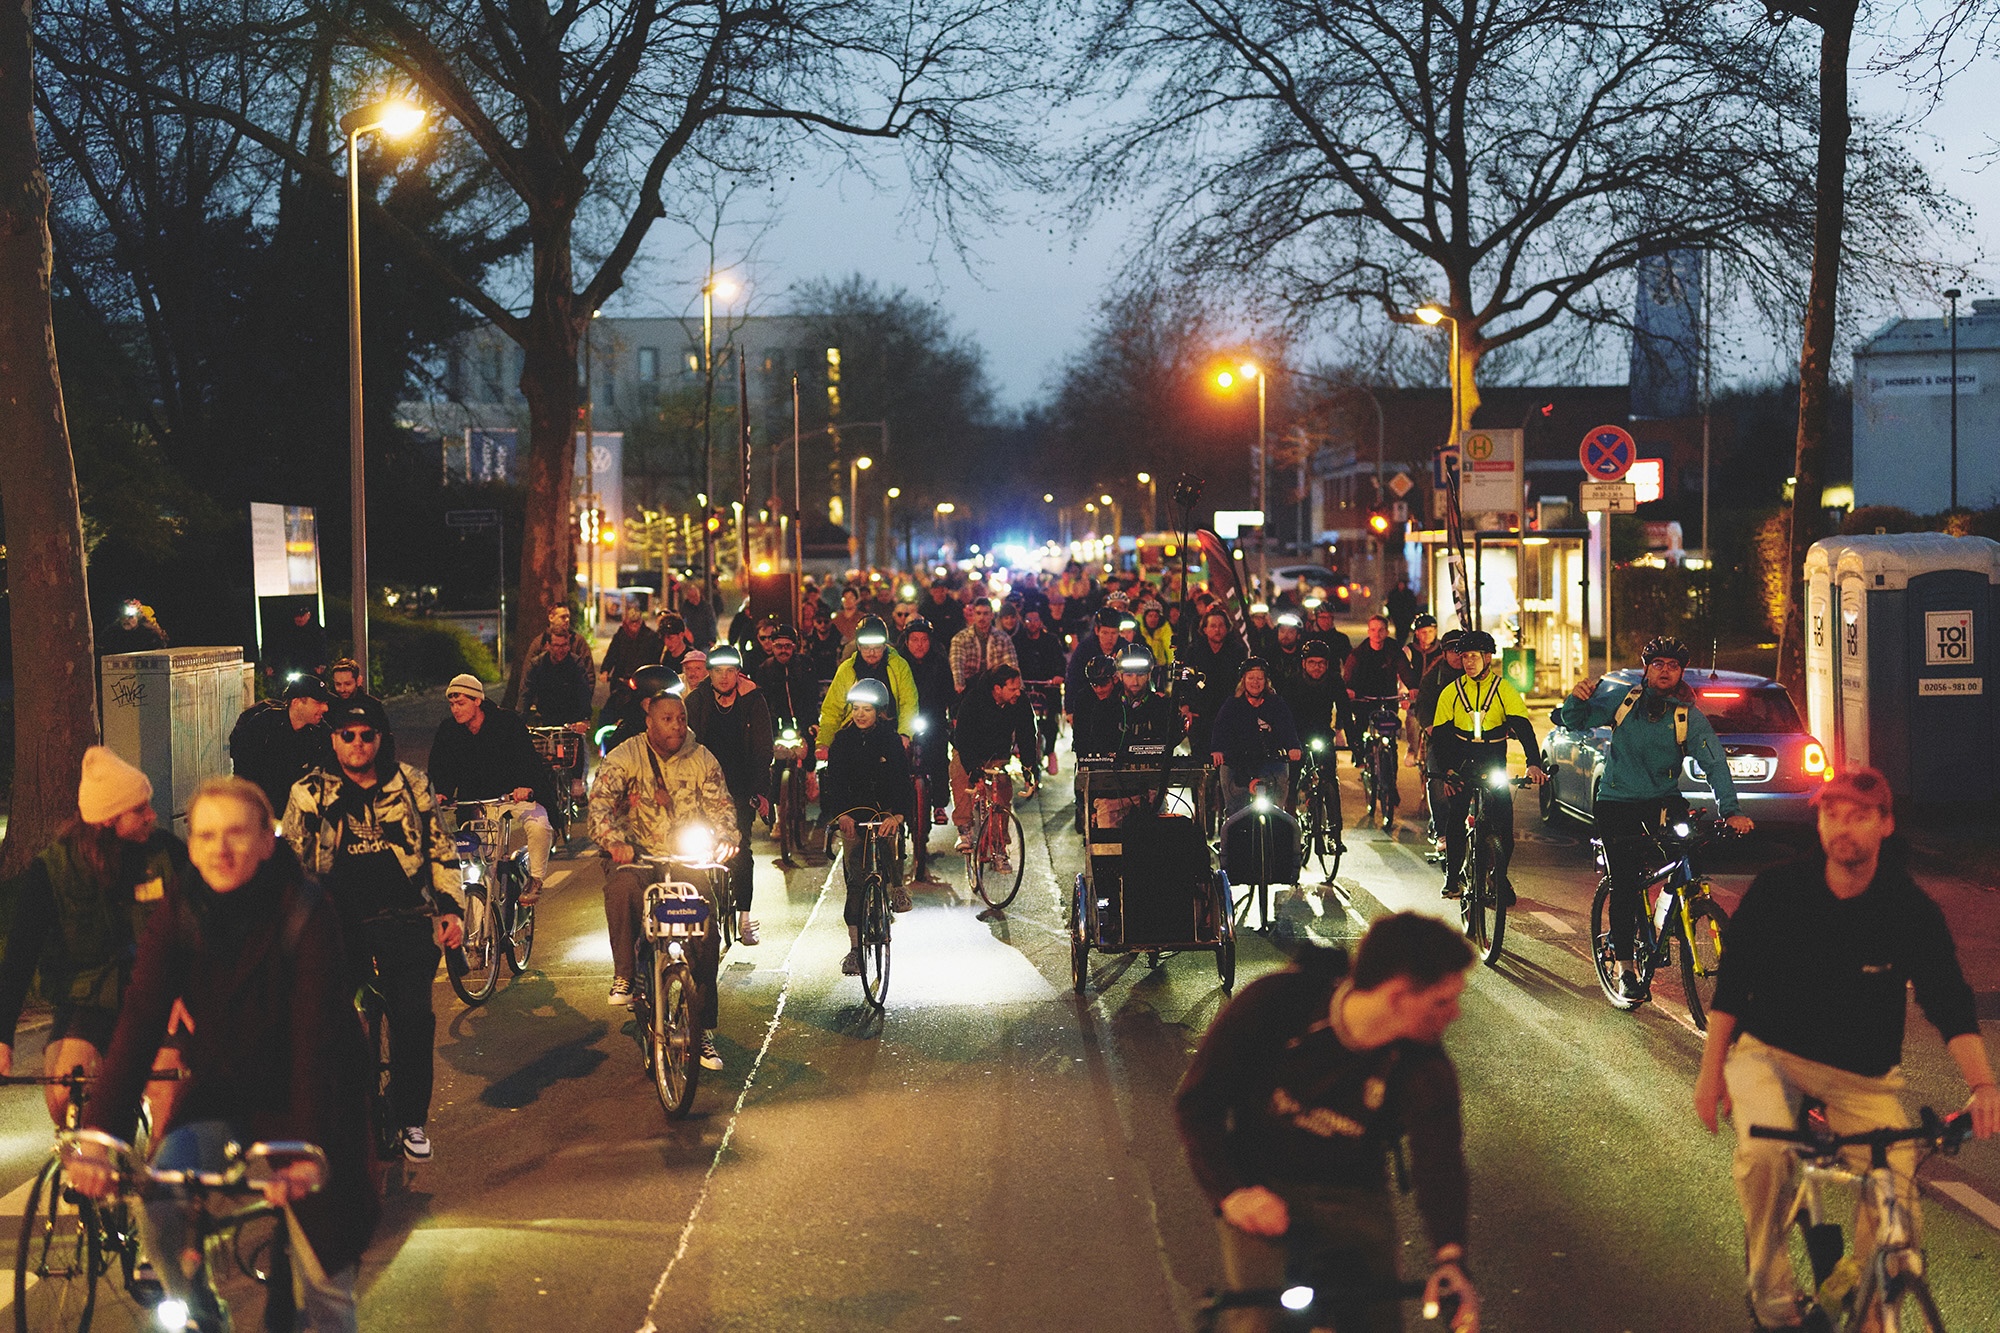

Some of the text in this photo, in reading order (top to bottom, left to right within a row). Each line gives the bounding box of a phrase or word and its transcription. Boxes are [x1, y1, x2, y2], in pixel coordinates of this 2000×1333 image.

[1937, 626, 1967, 642] TOI
[1937, 642, 1967, 659] TOI
[1967, 682, 1977, 691] 00
